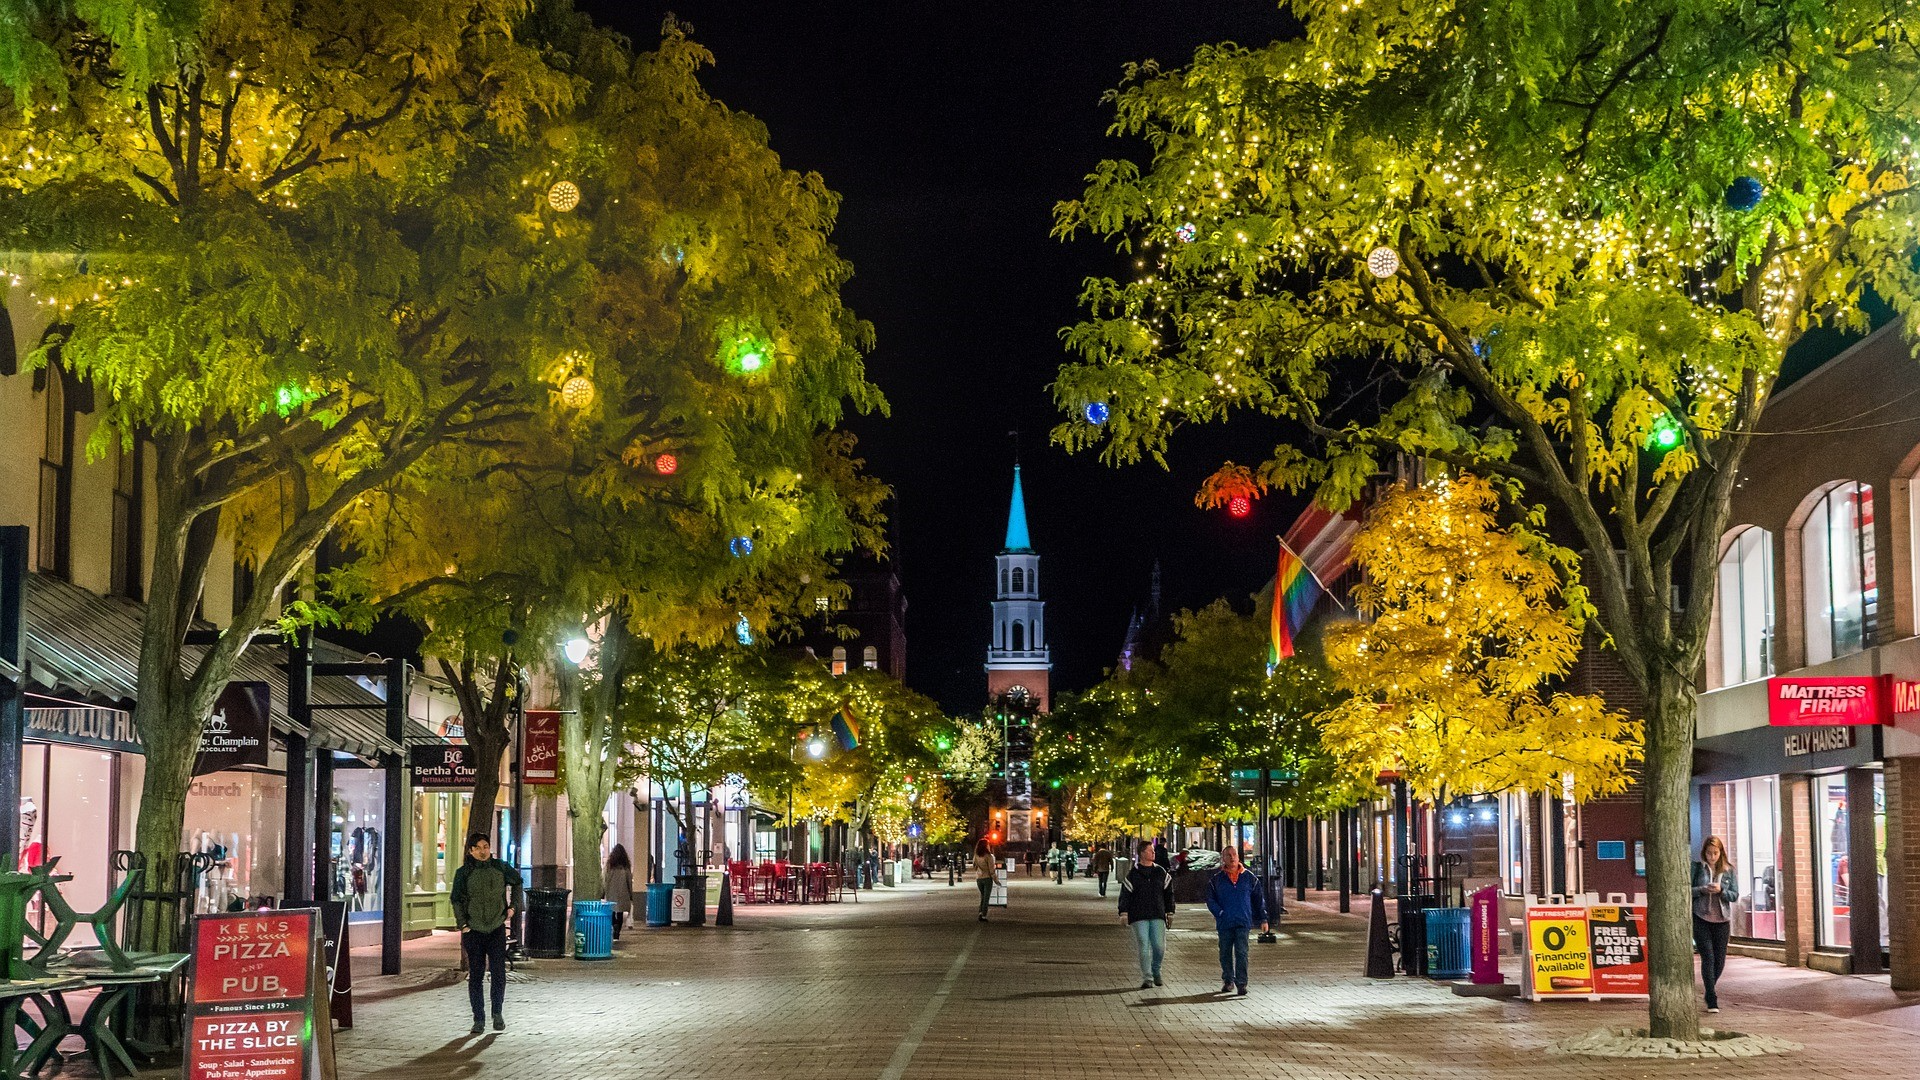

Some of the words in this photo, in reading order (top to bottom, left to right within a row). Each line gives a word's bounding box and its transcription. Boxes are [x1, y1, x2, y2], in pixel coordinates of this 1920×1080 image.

[1780, 684, 1866, 698] MATTRESS
[1800, 699, 1848, 714] FIRM
[212, 736, 259, 747] Champlain
[1784, 733, 1810, 757] HELLY
[1813, 726, 1849, 752] HANSEN
[527, 750, 556, 763] LOCAL
[415, 766, 451, 775] Bertha
[190, 782, 241, 796] Church
[220, 921, 288, 934] KEN'S
[1594, 927, 1627, 936] FREE
[1543, 925, 1577, 951] 0%
[1595, 937, 1647, 946] ADJUST
[214, 942, 291, 960] PIZZA
[1535, 951, 1586, 962] Financing
[1596, 956, 1630, 965] BASE
[241, 963, 264, 973] AND
[1537, 962, 1585, 972] Available
[207, 1022, 259, 1035] PIZZA
[266, 1020, 290, 1032] BY
[198, 1038, 236, 1050] THE
[243, 1035, 298, 1048] SLICE
[199, 1061, 218, 1070] Soup
[251, 1058, 294, 1066] Sandwiches
[246, 1068, 286, 1077] Appetizers
